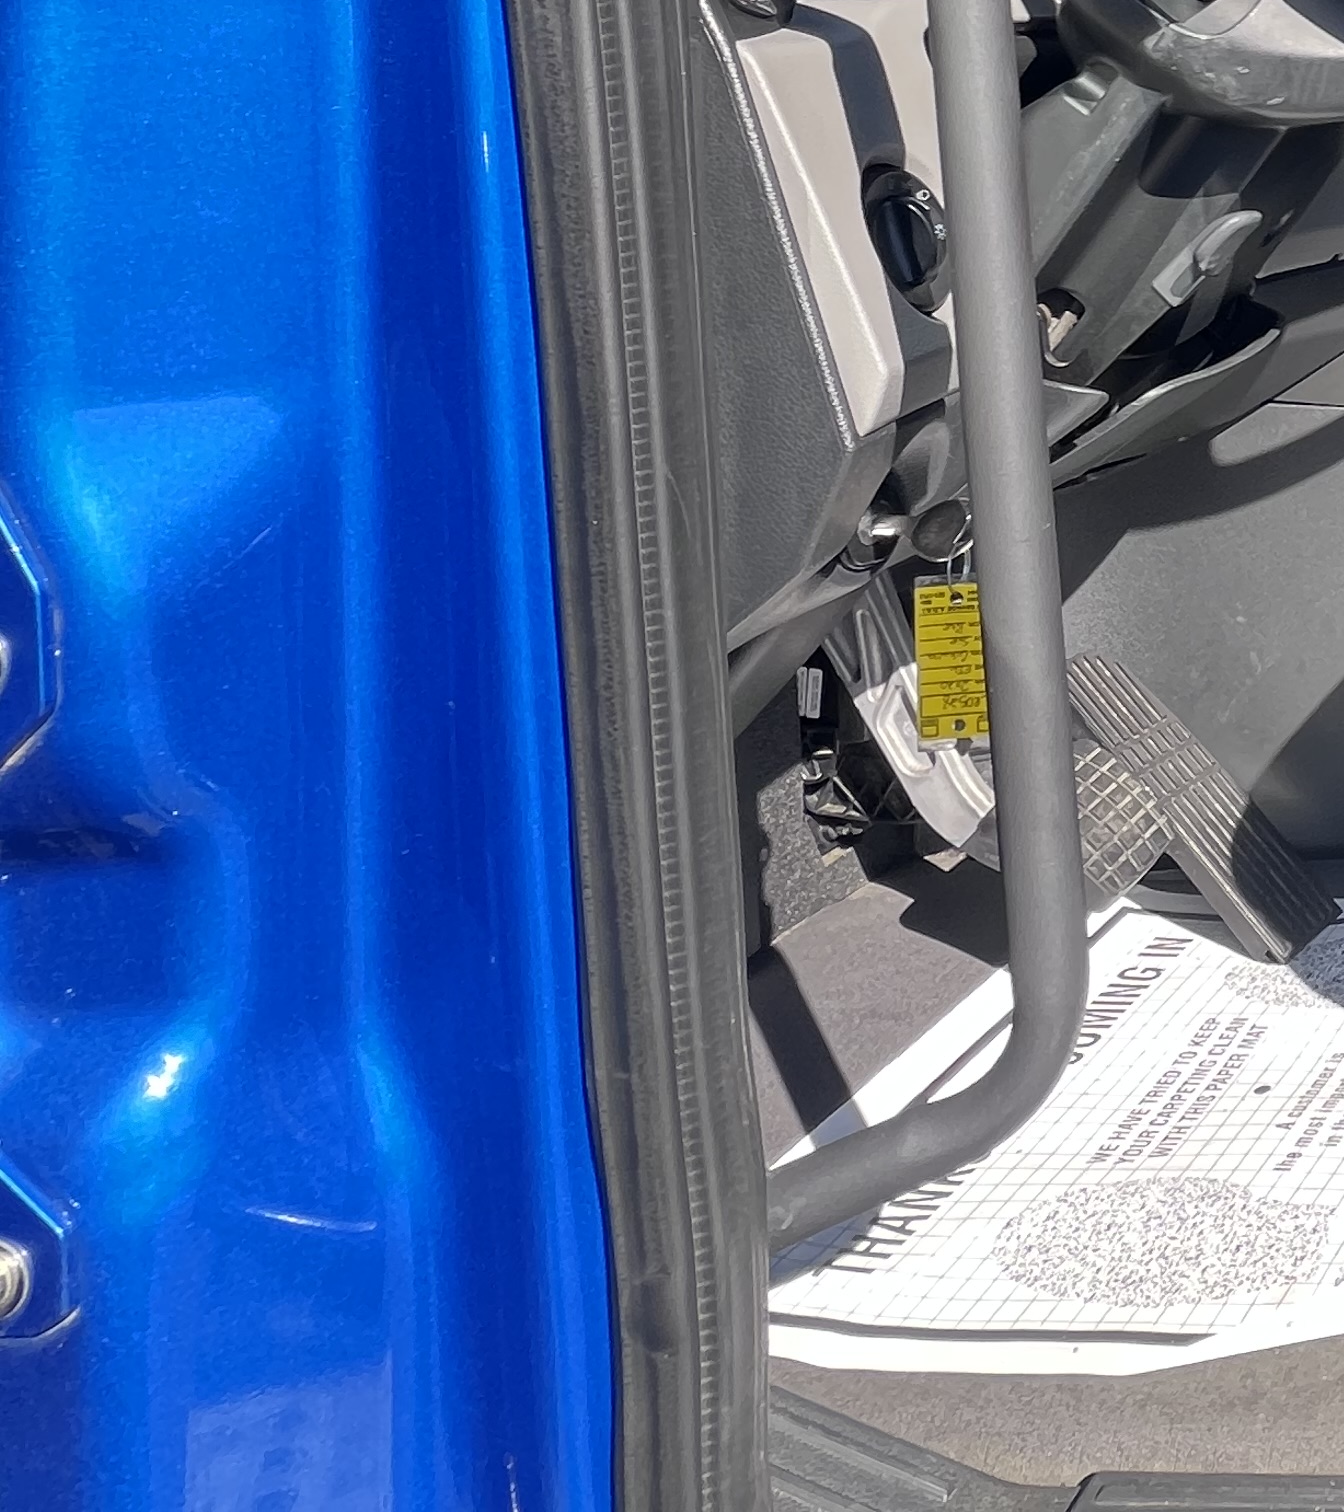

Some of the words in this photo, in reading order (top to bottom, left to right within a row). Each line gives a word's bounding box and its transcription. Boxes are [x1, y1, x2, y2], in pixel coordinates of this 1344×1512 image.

[1138, 936, 1194, 959] IN
[1086, 1144, 1120, 1164] WE
[1108, 1109, 1151, 1140] HAVE
[1139, 1069, 1182, 1105] TRIED
[1172, 1051, 1198, 1066] TO
[1188, 1017, 1221, 1047] KEEP
[1113, 1131, 1160, 1166] YOUR
[1150, 1059, 1217, 1126] CARPETING
[1208, 1017, 1249, 1056] CLEAN
[1148, 1126, 1192, 1158] WITH
[1179, 1095, 1216, 1122] THIS
[1205, 1053, 1250, 1091] PAPER
[1237, 1023, 1269, 1049] MAT
[1275, 1121, 1296, 1130] A
[1287, 1067, 1337, 1118] customer
[1272, 1152, 1303, 1172] the
[1295, 1116, 1327, 1148] most
[1319, 1134, 1343, 1147] in
